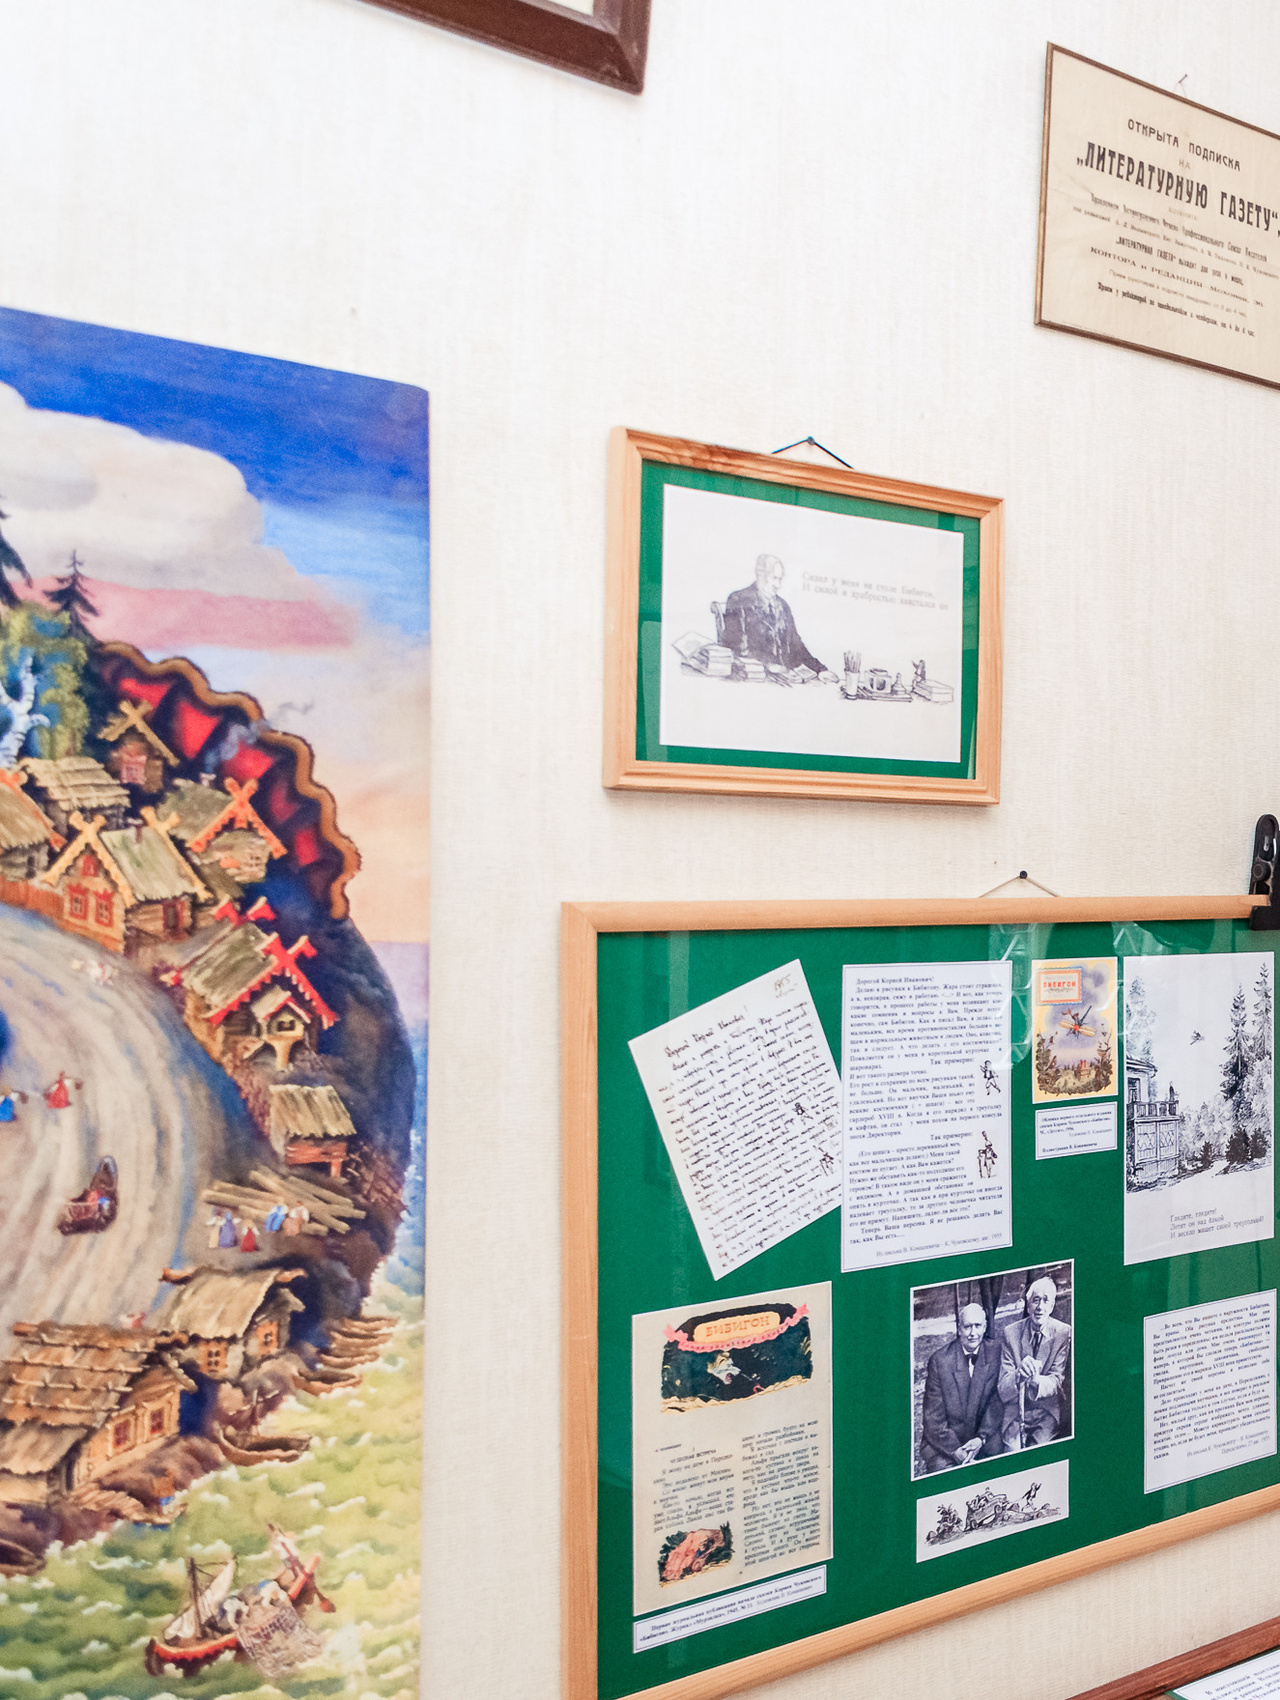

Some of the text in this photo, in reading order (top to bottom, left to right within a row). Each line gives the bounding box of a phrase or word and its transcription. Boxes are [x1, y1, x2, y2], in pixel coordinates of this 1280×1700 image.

[1127, 118, 1240, 172] ОТКРЫТА ПОДПИСКА
[1076, 140, 1208, 210] „ЛИТЕРАТУРНУЮ
[1178, 158, 1190, 170] НА
[706, 1316, 770, 1337] БИБИГОН
